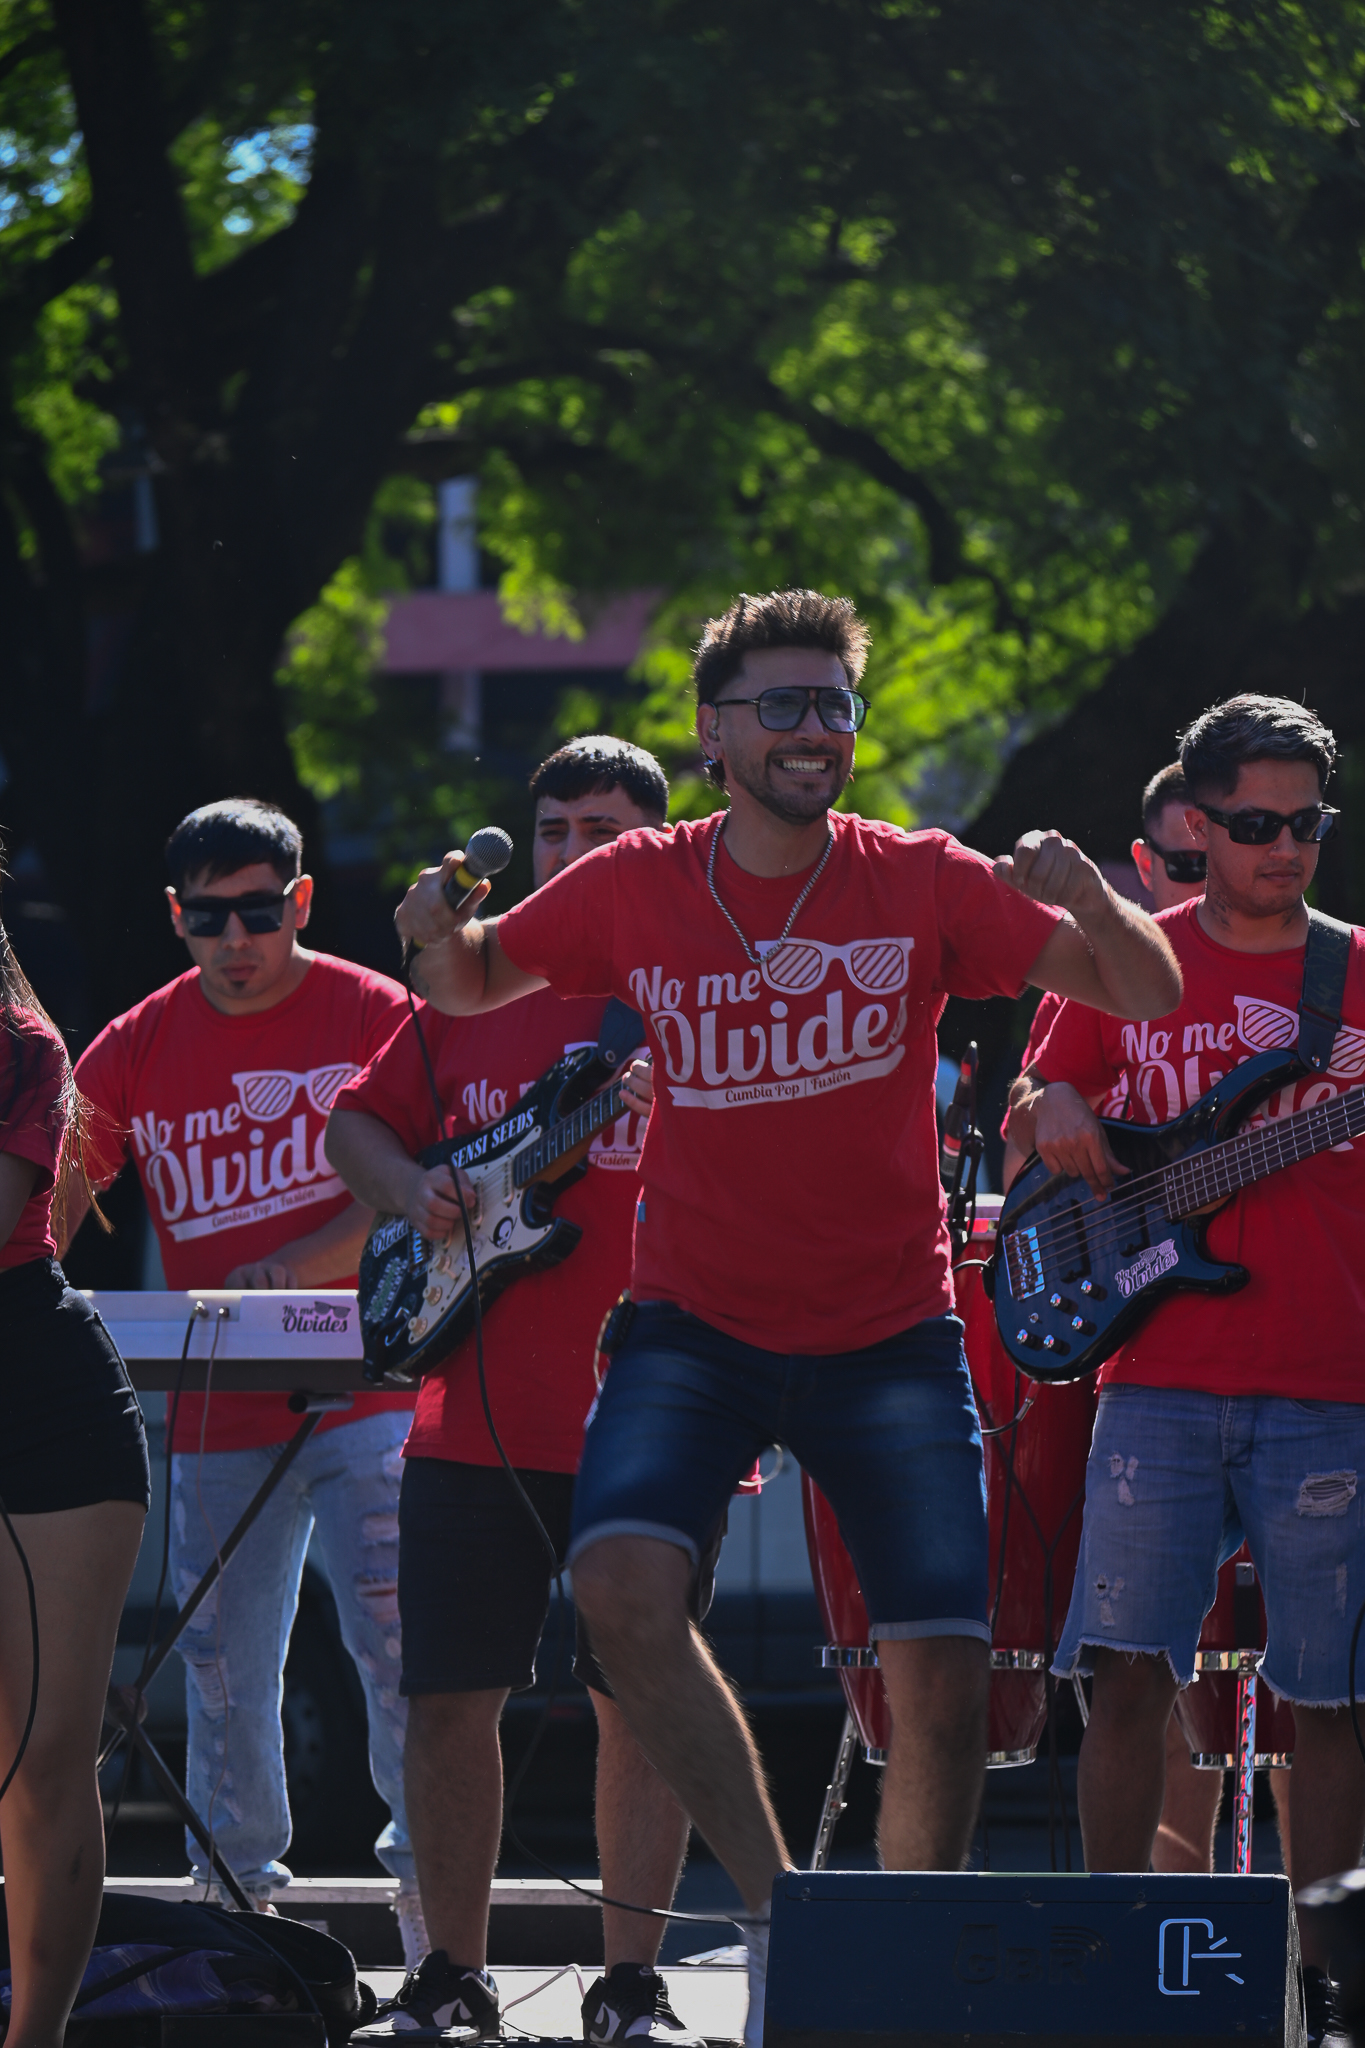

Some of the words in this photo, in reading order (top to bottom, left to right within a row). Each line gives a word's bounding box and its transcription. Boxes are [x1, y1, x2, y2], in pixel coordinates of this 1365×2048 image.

[628, 966, 685, 1012] No
[698, 969, 761, 1007] me
[1121, 1020, 1173, 1064] No
[1182, 1022, 1236, 1054] me
[462, 1078, 508, 1125] No
[725, 1085, 773, 1103] Cumbia
[774, 1083, 800, 1098] Pop
[810, 1068, 852, 1091] Fusión
[131, 1111, 175, 1157] No
[184, 1102, 242, 1143] me
[451, 1133, 489, 1168] SENSI
[491, 1106, 535, 1149] SEEDS
[593, 1153, 630, 1166] Fusión
[1118, 1250, 1179, 1298] Olvides
[282, 1315, 348, 1333] Olvides
